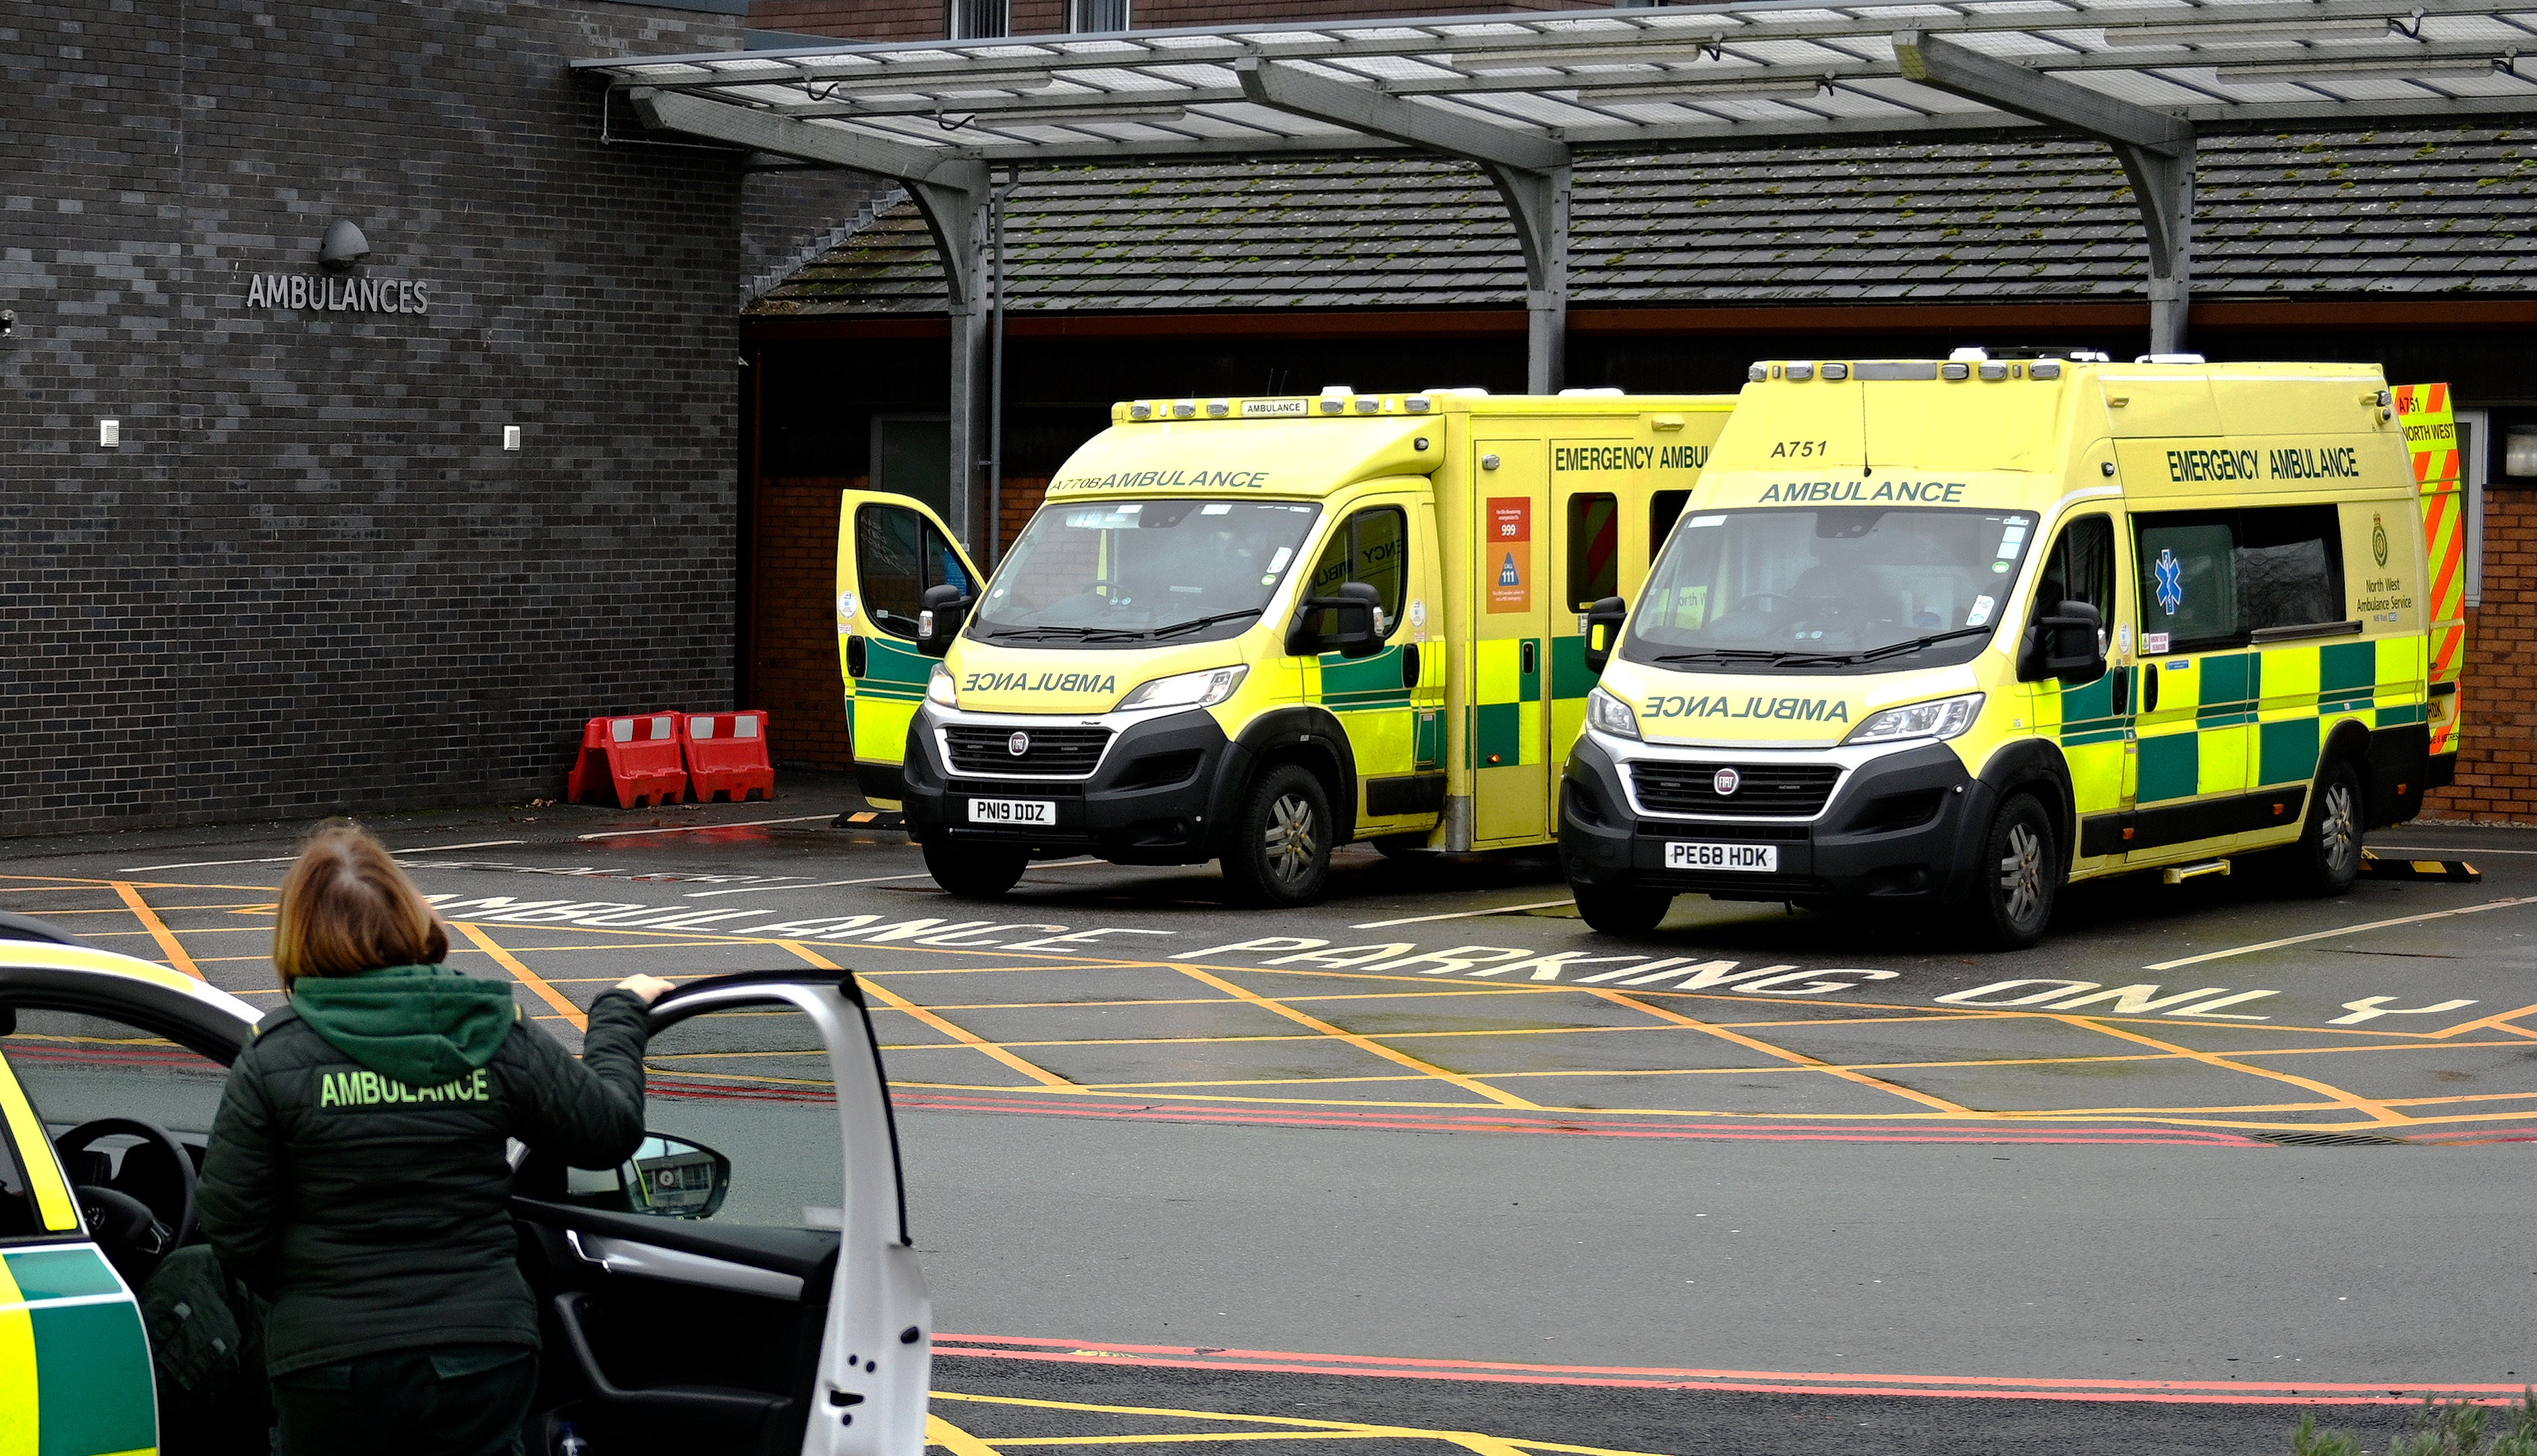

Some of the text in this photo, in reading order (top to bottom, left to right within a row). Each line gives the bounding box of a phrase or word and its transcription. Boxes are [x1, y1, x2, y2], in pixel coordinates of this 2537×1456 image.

[246, 274, 428, 314] AMBULANCES
[1247, 403, 1301, 412] AMBULANCE
[2399, 397, 2420, 413] A751
[2430, 424, 2453, 440] WEST
[1556, 446, 1654, 471] EMERGENCY
[1770, 441, 1827, 458] A751
[2166, 447, 2359, 482] EMERGENCY AMBULANCE
[1049, 471, 1270, 490] A770B AMBULANCE
[1758, 482, 1966, 503] AMBULANCE
[1501, 524, 1516, 536] 999
[1502, 571, 1515, 583] 111
[2366, 577, 2400, 593] North West
[2357, 594, 2412, 612] Ambulance Service
[1719, 776, 1734, 788] FIAT
[977, 801, 1045, 821] PN19 DDZ
[1674, 845, 1767, 867] PE68 HDK
[1168, 936, 1901, 995] PARKING
